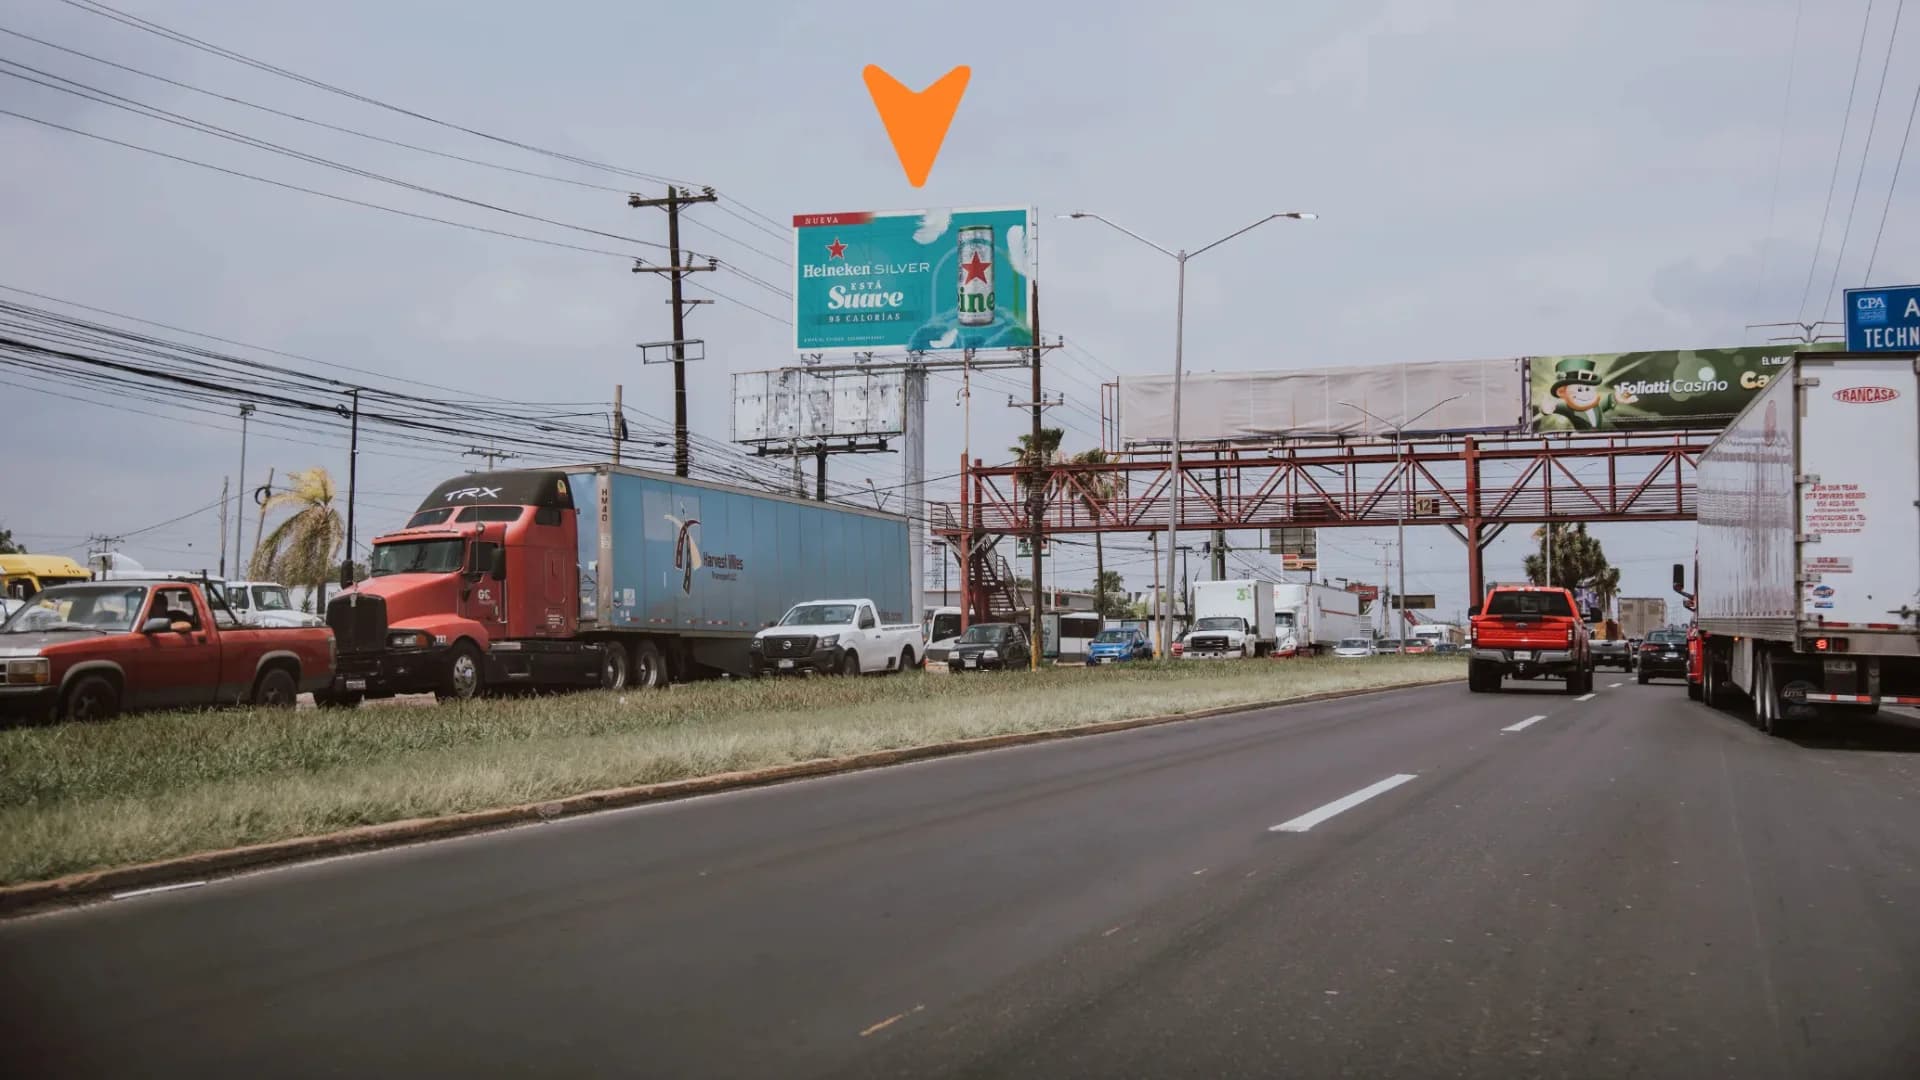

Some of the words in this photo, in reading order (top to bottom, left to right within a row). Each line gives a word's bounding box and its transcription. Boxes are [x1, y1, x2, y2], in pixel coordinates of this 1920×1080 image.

[804, 216, 840, 225] NUEVA
[803, 263, 871, 278] Heineken
[873, 262, 931, 275] SILVER
[851, 280, 882, 290] ESTÁ
[827, 285, 904, 310] Suave
[1857, 296, 1887, 310] CPA
[1864, 326, 1920, 349] TECHN
[1620, 379, 1670, 396] Foliatti
[1672, 378, 1728, 394] Casino
[1740, 370, 1775, 390] Ca
[1836, 389, 1895, 402] TRANCASA
[445, 487, 503, 503] TRX
[1416, 498, 1431, 511] 12
